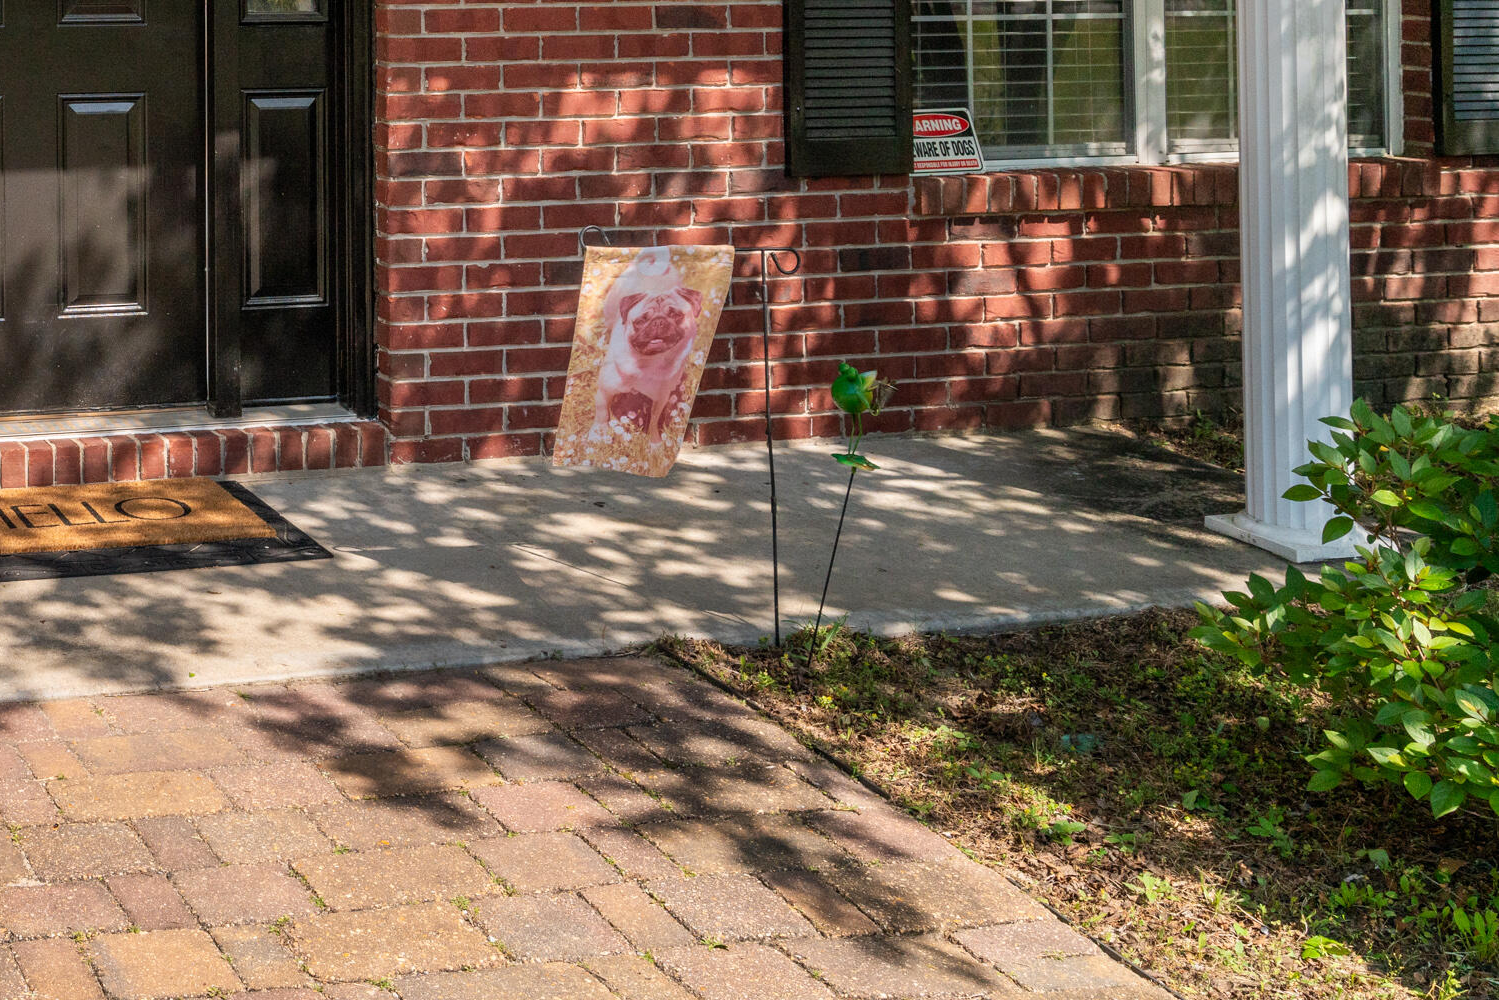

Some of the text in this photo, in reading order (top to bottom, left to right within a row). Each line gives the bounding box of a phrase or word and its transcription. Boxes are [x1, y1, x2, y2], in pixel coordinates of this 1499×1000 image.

[915, 119, 962, 131] ARNING
[939, 141, 951, 157] OF
[951, 140, 975, 155] DOGS
